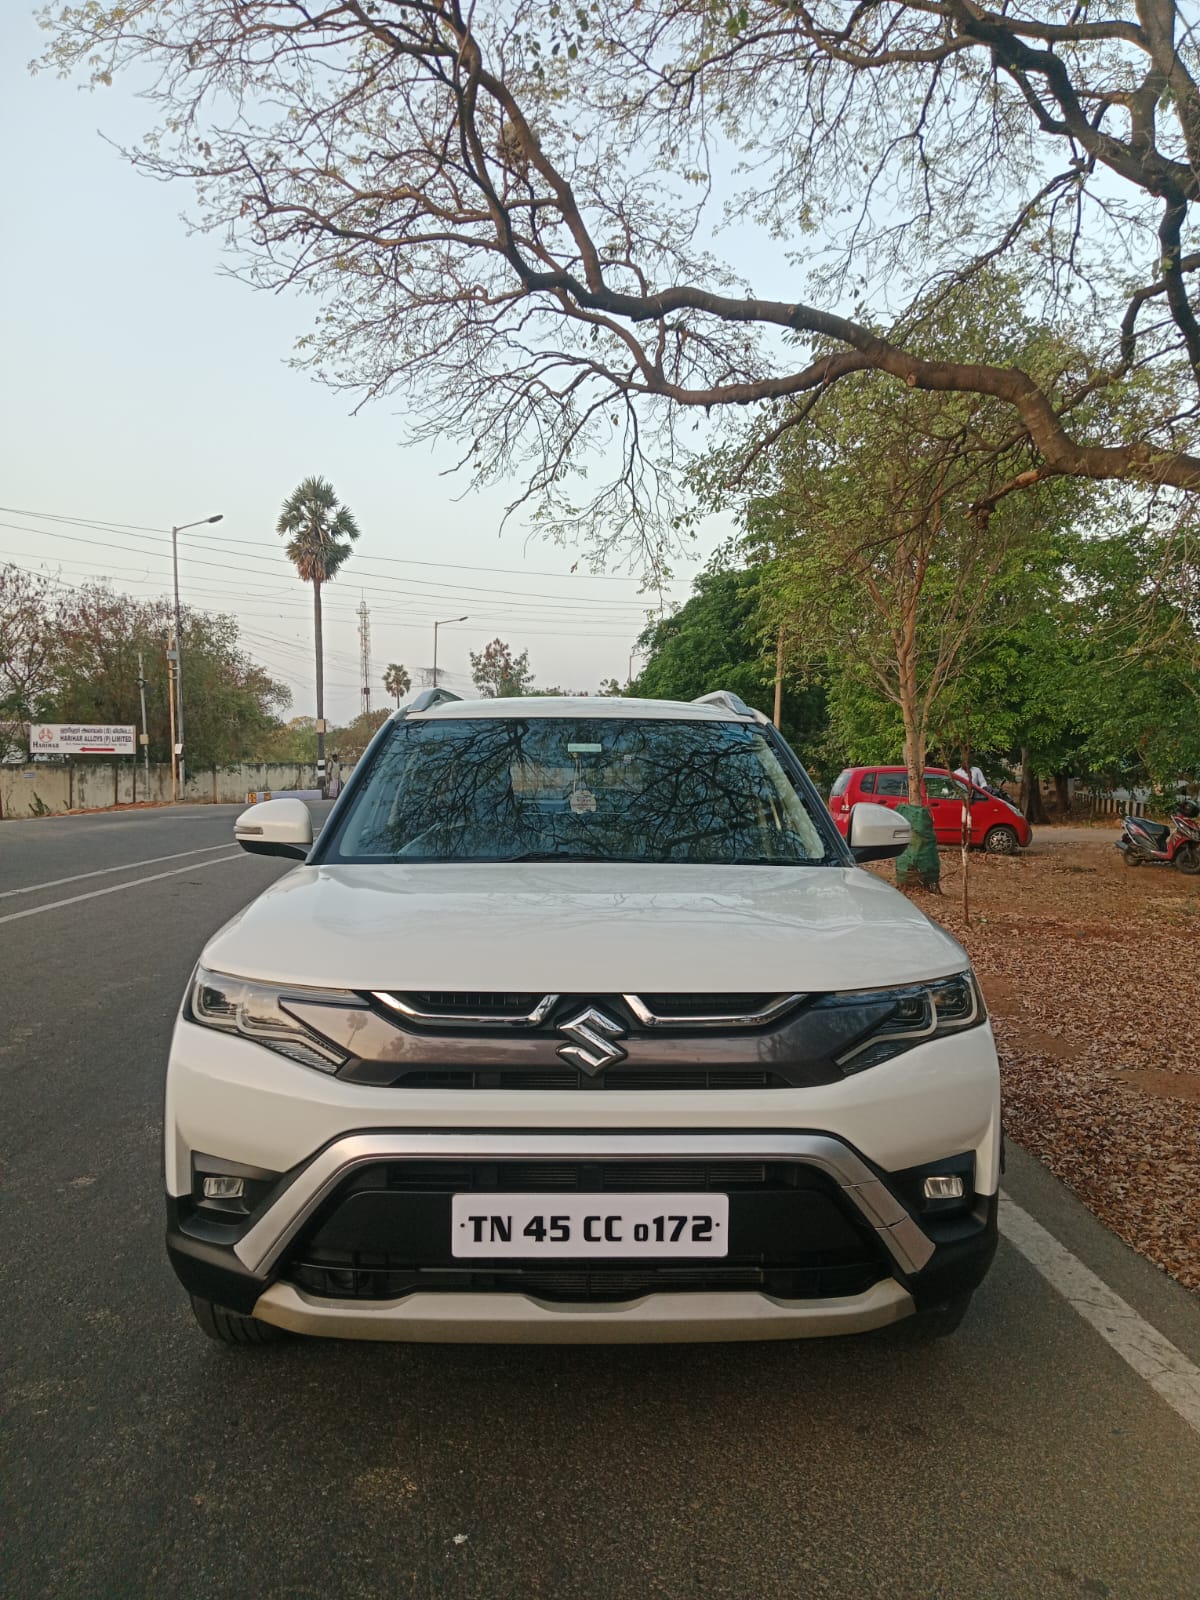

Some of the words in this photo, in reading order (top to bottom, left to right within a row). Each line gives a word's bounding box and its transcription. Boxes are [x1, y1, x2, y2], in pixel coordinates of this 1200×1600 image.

[84, 735, 103, 743] ALLOYS
[468, 1215, 512, 1242] TN
[523, 1215, 571, 1242] 45
[583, 1215, 623, 1242] CC
[633, 1215, 713, 1242] 0172
